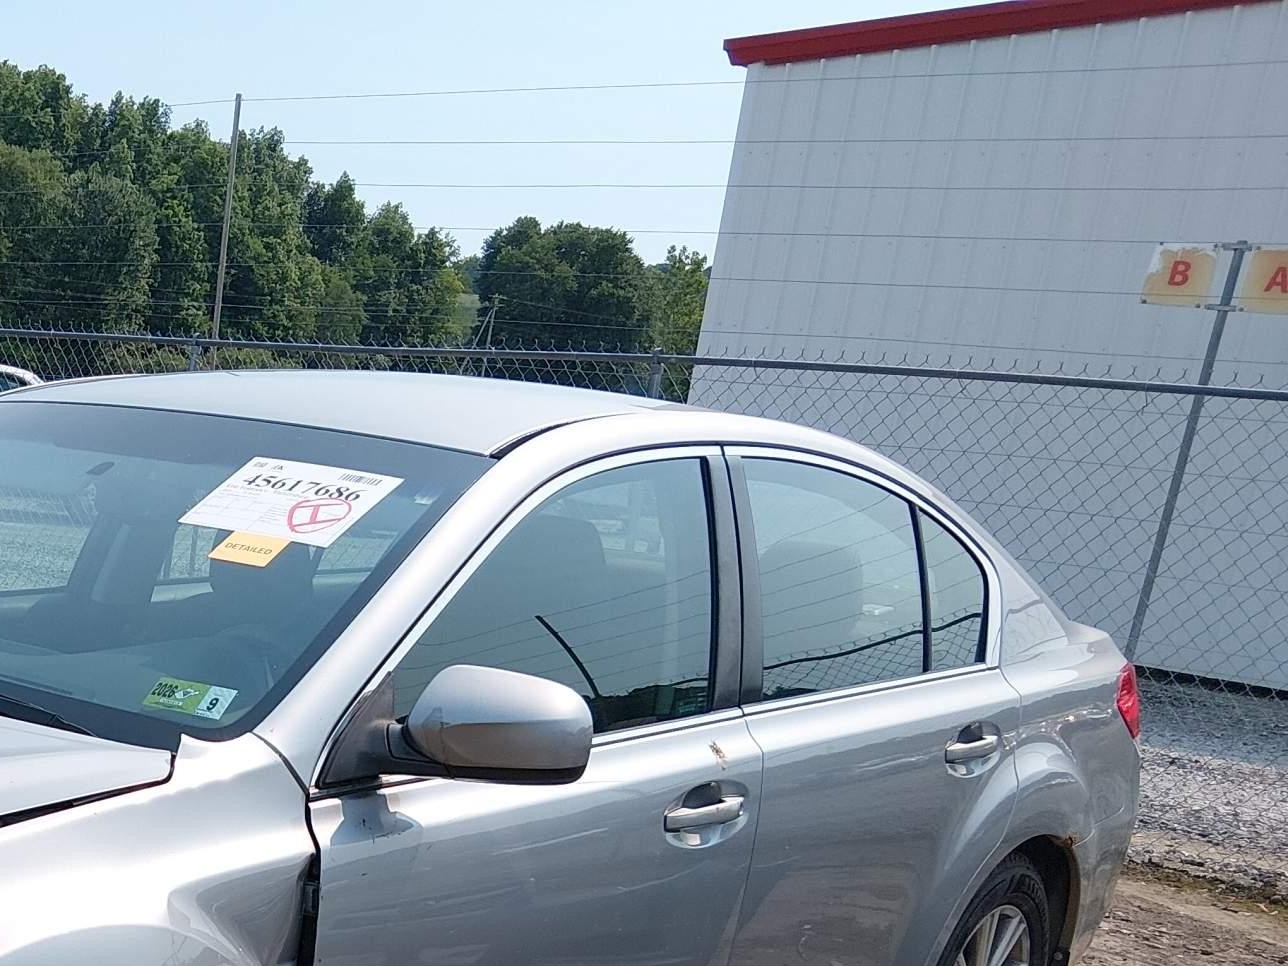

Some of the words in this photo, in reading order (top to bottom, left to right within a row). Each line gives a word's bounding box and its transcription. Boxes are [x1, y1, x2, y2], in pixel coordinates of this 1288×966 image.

[1168, 261, 1192, 287] B
[1264, 266, 1288, 293] A
[243, 473, 366, 501] 45617686
[224, 541, 273, 556] DETAILED
[151, 682, 179, 699] 2026
[206, 697, 220, 712] 9
